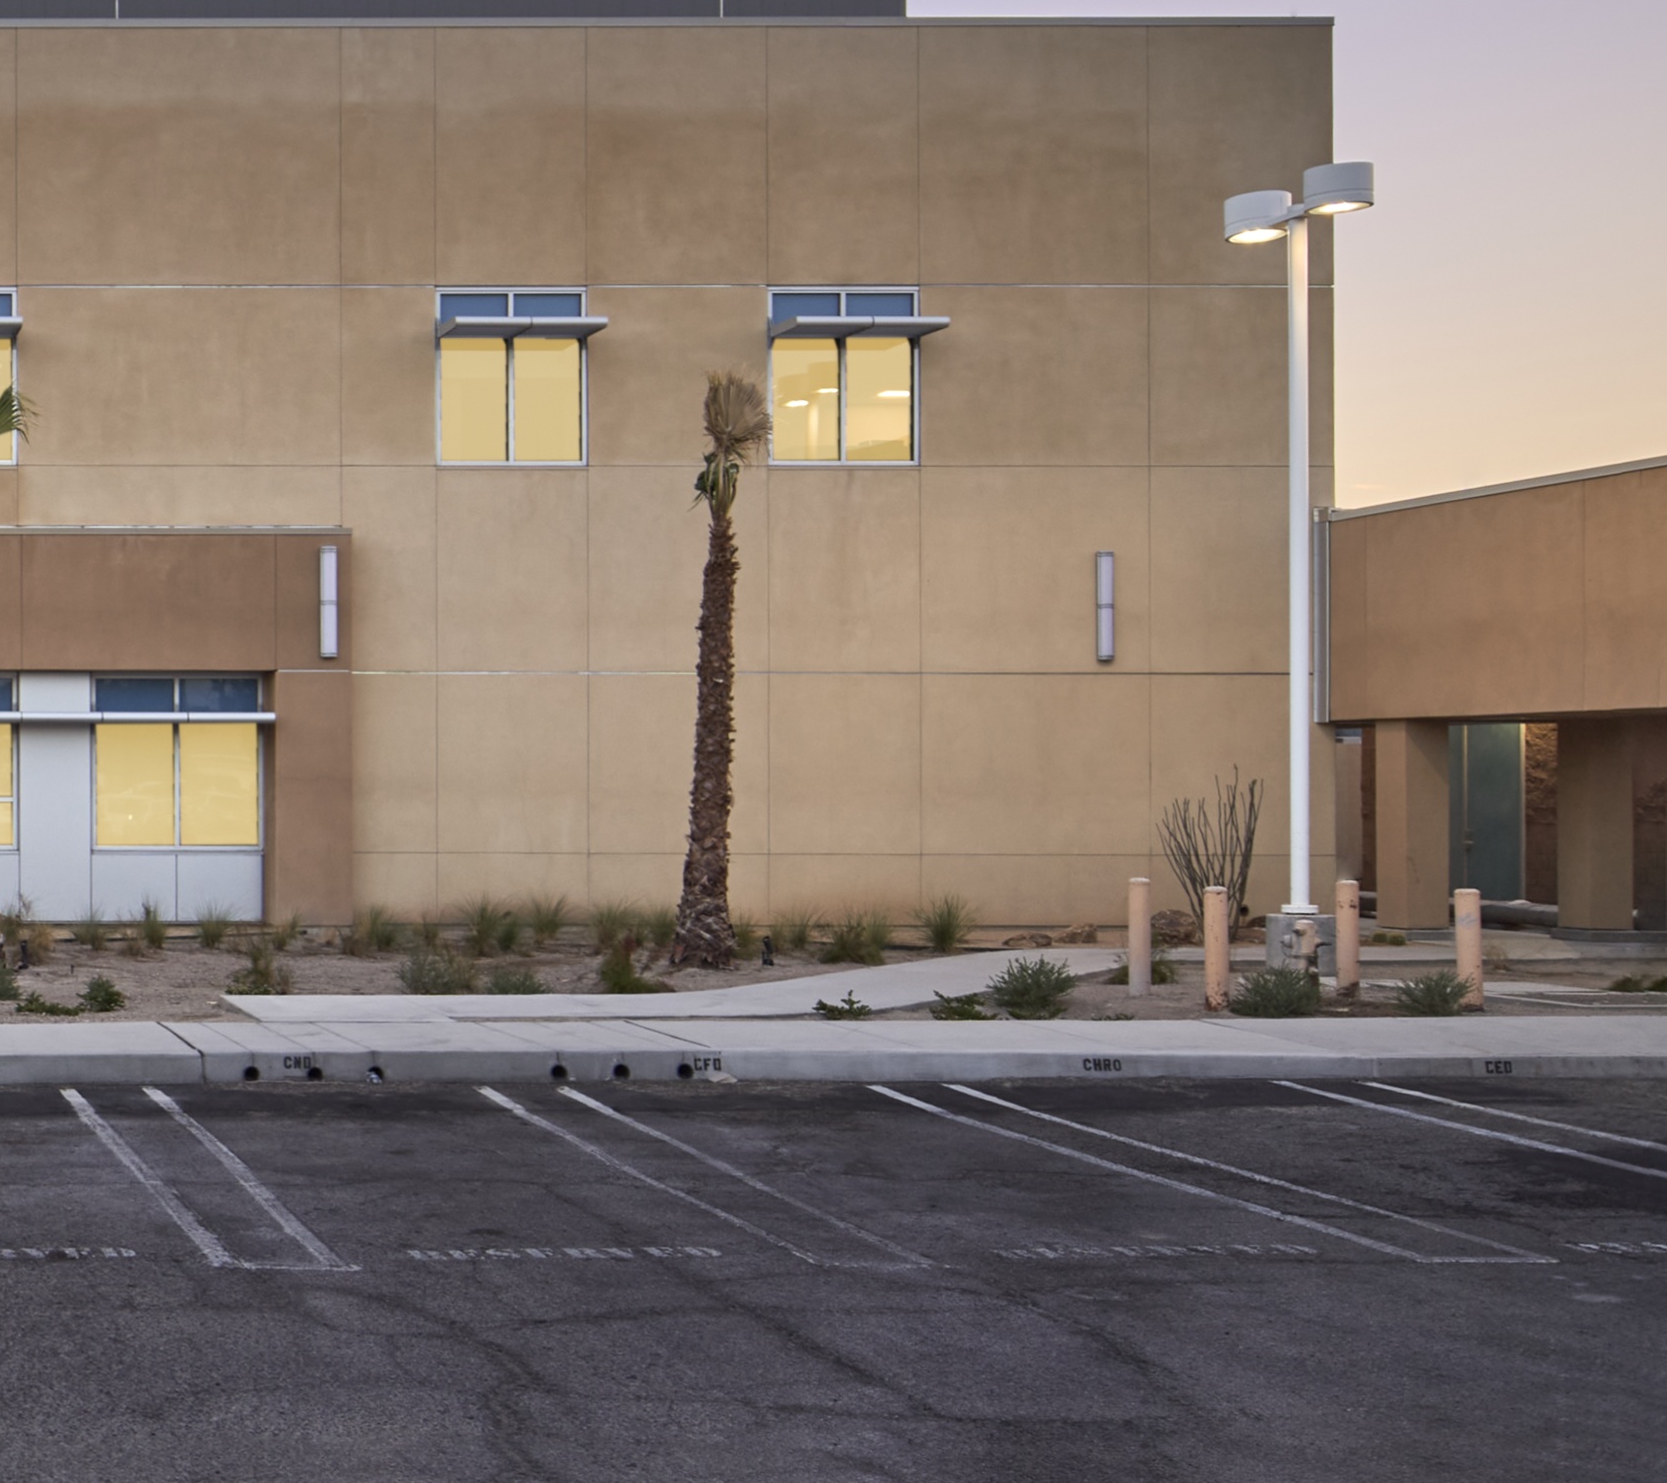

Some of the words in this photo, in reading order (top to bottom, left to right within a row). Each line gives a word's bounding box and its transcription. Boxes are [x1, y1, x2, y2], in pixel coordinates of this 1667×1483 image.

[693, 1057, 722, 1071] CFO
[1083, 1059, 1122, 1071] CHRO
[1486, 1061, 1512, 1074] CEO
[406, 1247, 724, 1261] RESERVED
